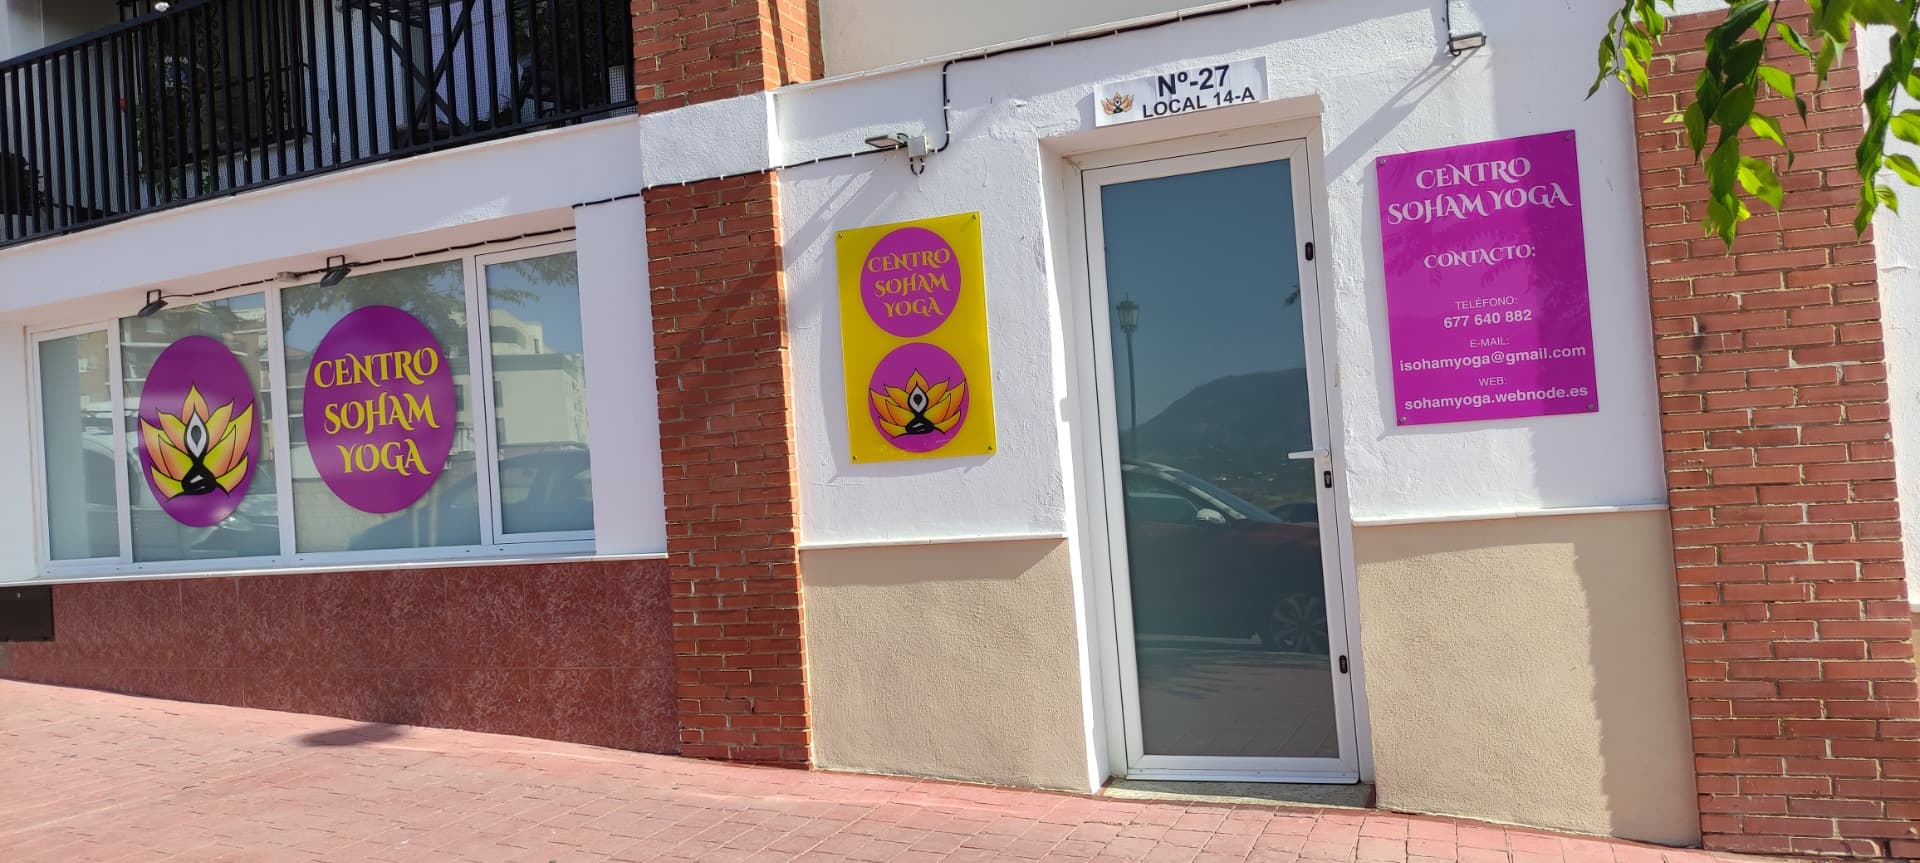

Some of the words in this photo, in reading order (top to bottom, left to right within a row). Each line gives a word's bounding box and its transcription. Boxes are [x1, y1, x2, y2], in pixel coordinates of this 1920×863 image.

[1143, 95, 1207, 118] LOCAL
[1213, 87, 1255, 106] 14-A
[1416, 157, 1531, 190] CENTRO
[1387, 193, 1487, 225] SOHAM
[1487, 182, 1575, 210] YOGA
[867, 248, 951, 273] CENTRO
[1424, 244, 1536, 269] CONTACTO:
[873, 273, 952, 298] SOHAM
[882, 296, 944, 318] YOGA
[1456, 296, 1518, 310] TELÉFONO:
[1443, 315, 1469, 329] 677
[1474, 312, 1501, 326] 640
[1505, 310, 1532, 323] 882
[1469, 337, 1509, 348] E-MAIL:
[313, 346, 439, 389] CENTRO
[1399, 346, 1586, 372] isohamyoga@gmail.com
[1478, 377, 1507, 387] WEB:
[1404, 385, 1588, 410] sohamyoga.webnode.es
[323, 393, 441, 435] SOHAM
[335, 438, 431, 477] YOGA
